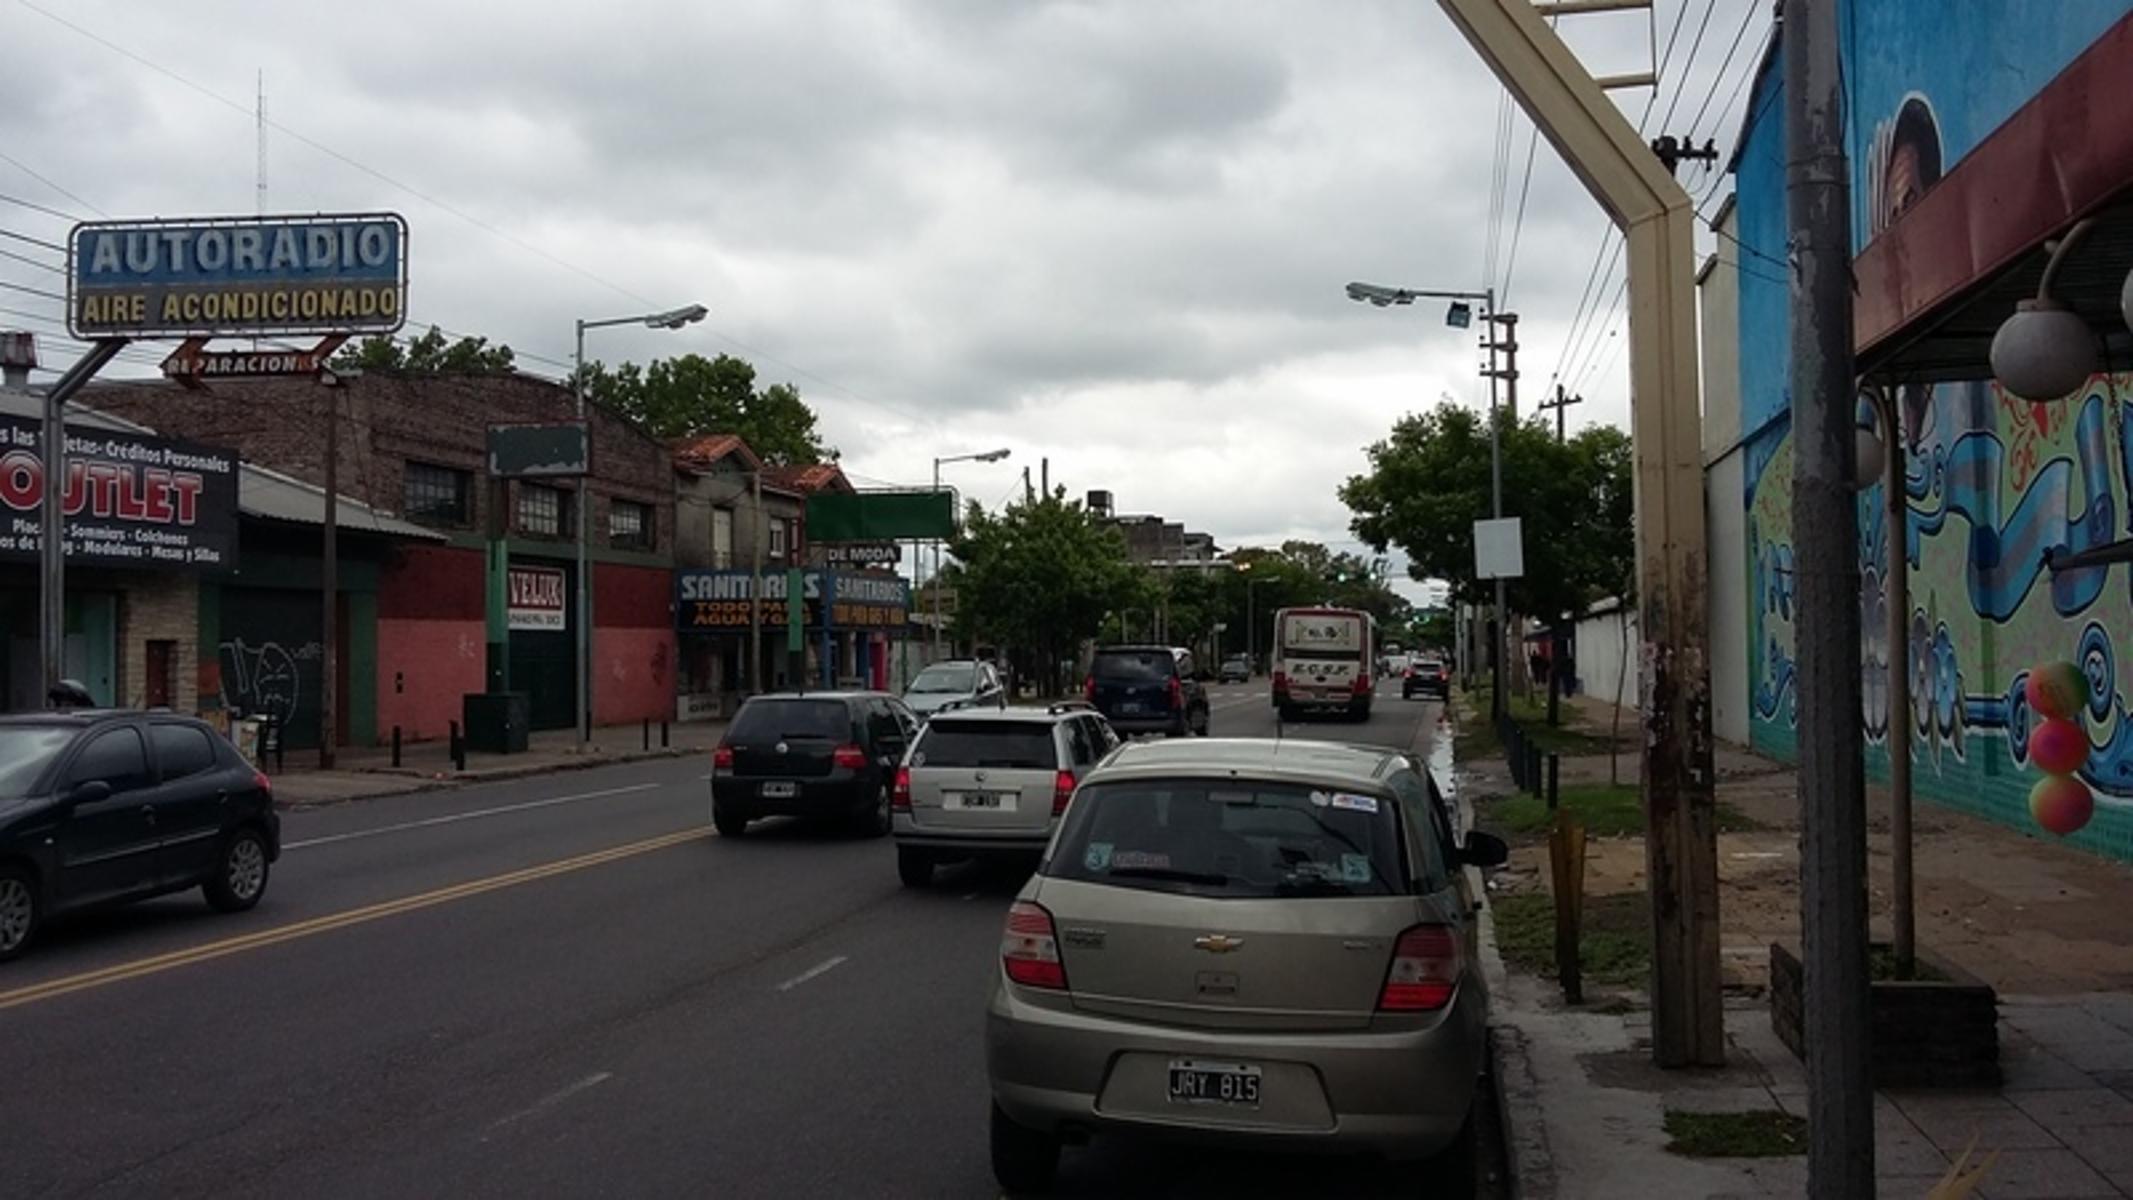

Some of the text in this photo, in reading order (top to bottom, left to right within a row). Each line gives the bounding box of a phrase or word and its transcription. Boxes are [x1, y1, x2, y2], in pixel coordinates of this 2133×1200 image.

[91, 224, 391, 274] AUTORADIO
[82, 287, 397, 323] AIRE ACONDICIONADO
[12, 426, 35, 446] las
[105, 440, 161, 463] Créditos
[164, 449, 230, 473] Personales
[0, 449, 204, 524] OUTLET
[71, 524, 126, 541] Sommiers
[135, 528, 188, 545] Colchones
[18, 535, 36, 550] de
[84, 540, 142, 557] Modulares
[152, 546, 186, 560] Mesas
[194, 548, 220, 562] Sillas
[828, 547, 897, 561] DE MODA
[681, 574, 819, 601] SANITRIS
[693, 613, 750, 625] AGUA
[694, 602, 750, 612] TODO
[1220, 1074, 1258, 1101] 815
